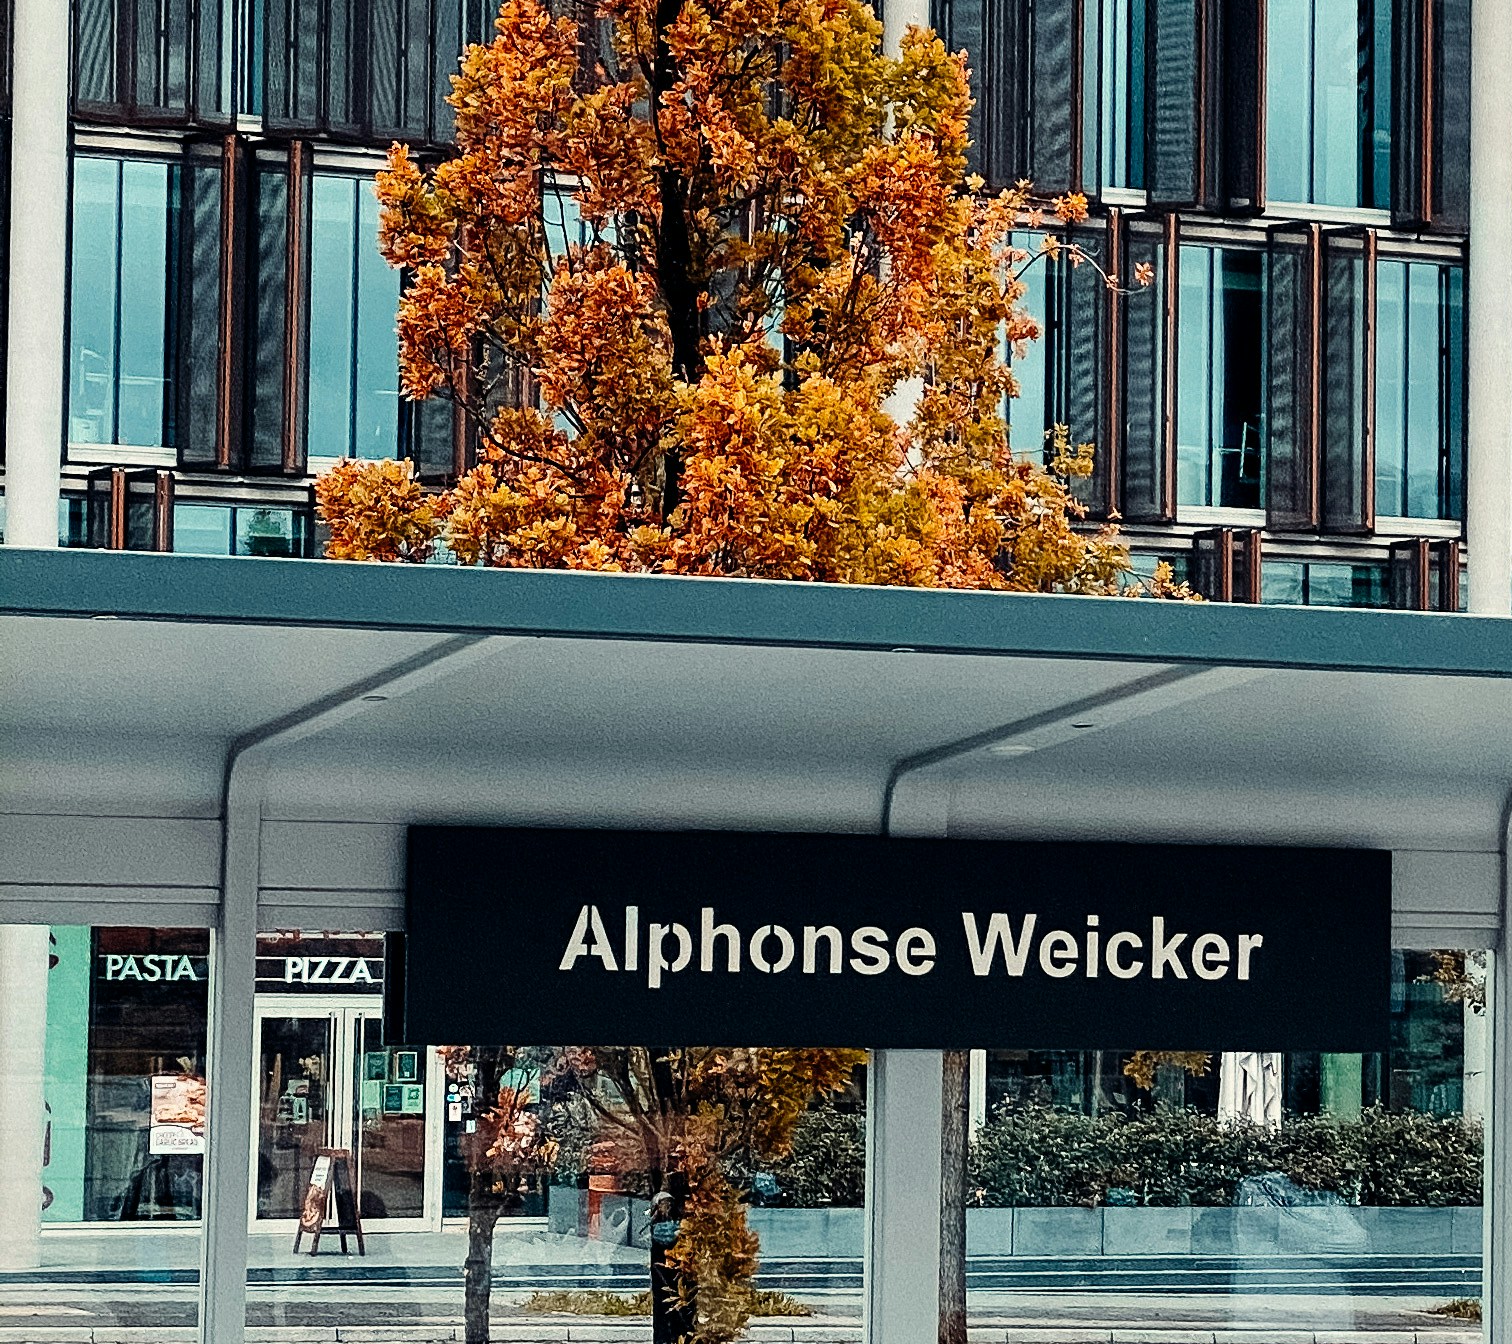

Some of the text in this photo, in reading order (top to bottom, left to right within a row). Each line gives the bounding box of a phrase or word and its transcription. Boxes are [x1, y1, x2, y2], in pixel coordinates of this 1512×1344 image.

[559, 905, 1263, 988] Alphonse Weicker
[106, 954, 197, 982] PASTA
[285, 956, 374, 984] PIZZA
